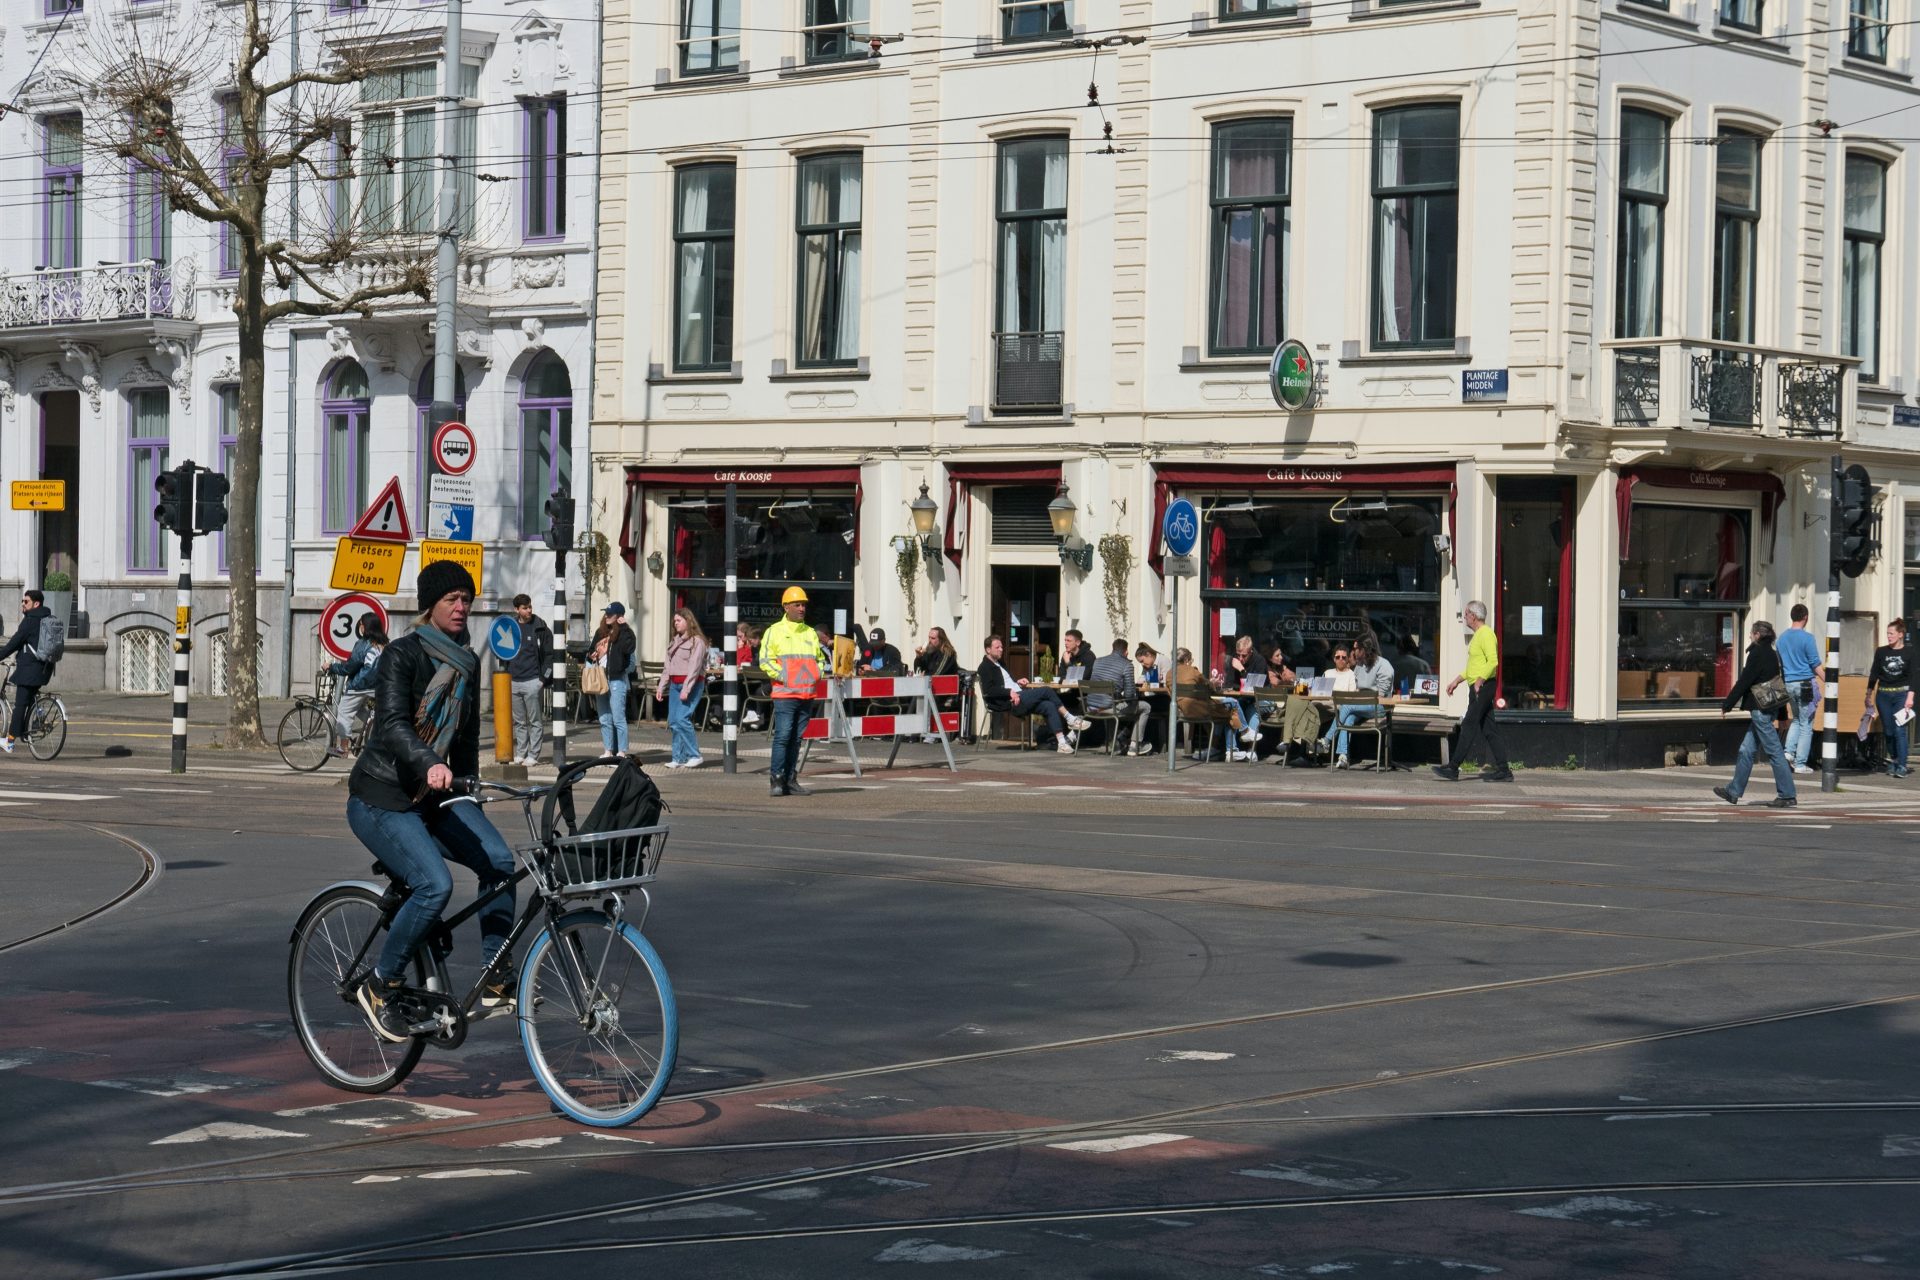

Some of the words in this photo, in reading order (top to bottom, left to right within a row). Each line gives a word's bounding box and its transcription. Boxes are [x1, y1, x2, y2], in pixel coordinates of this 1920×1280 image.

[1466, 371, 1499, 380] PLANTAGE
[1466, 381, 1493, 390] MIDDEN
[1466, 391, 1483, 399] LAAN
[714, 471, 736, 481] Café
[739, 471, 772, 483] Koosje
[1267, 469, 1296, 480] Café
[1301, 468, 1343, 482] Koosje
[350, 543, 393, 557] Fietsers
[426, 545, 457, 555] Voetpad
[459, 548, 479, 556] dicht
[362, 562, 375, 571] op
[346, 573, 384, 586] rijbaan
[1318, 620, 1360, 632] KOOSJE
